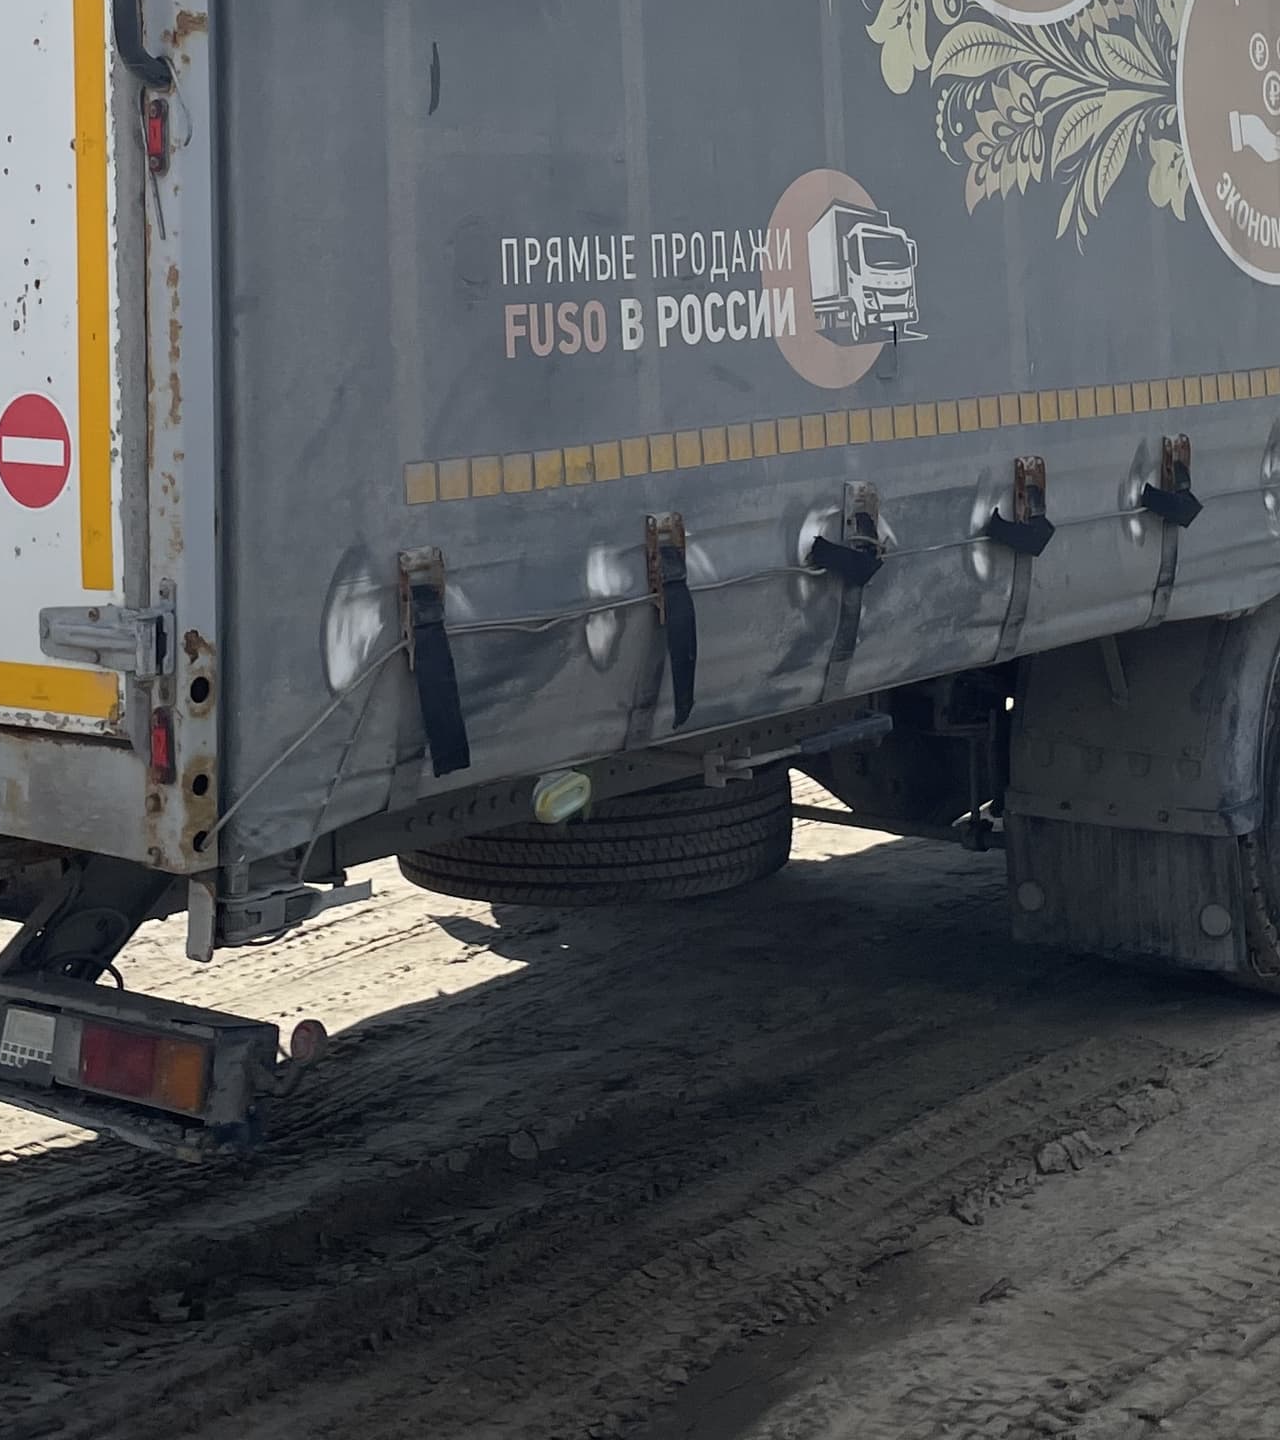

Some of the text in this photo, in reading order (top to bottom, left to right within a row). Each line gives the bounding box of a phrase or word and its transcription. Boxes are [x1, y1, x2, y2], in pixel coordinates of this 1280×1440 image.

[500, 227, 793, 285] ПРЯМЫЕ ПРОДАЖИ
[504, 287, 797, 359] FUSO В РОССИИ
